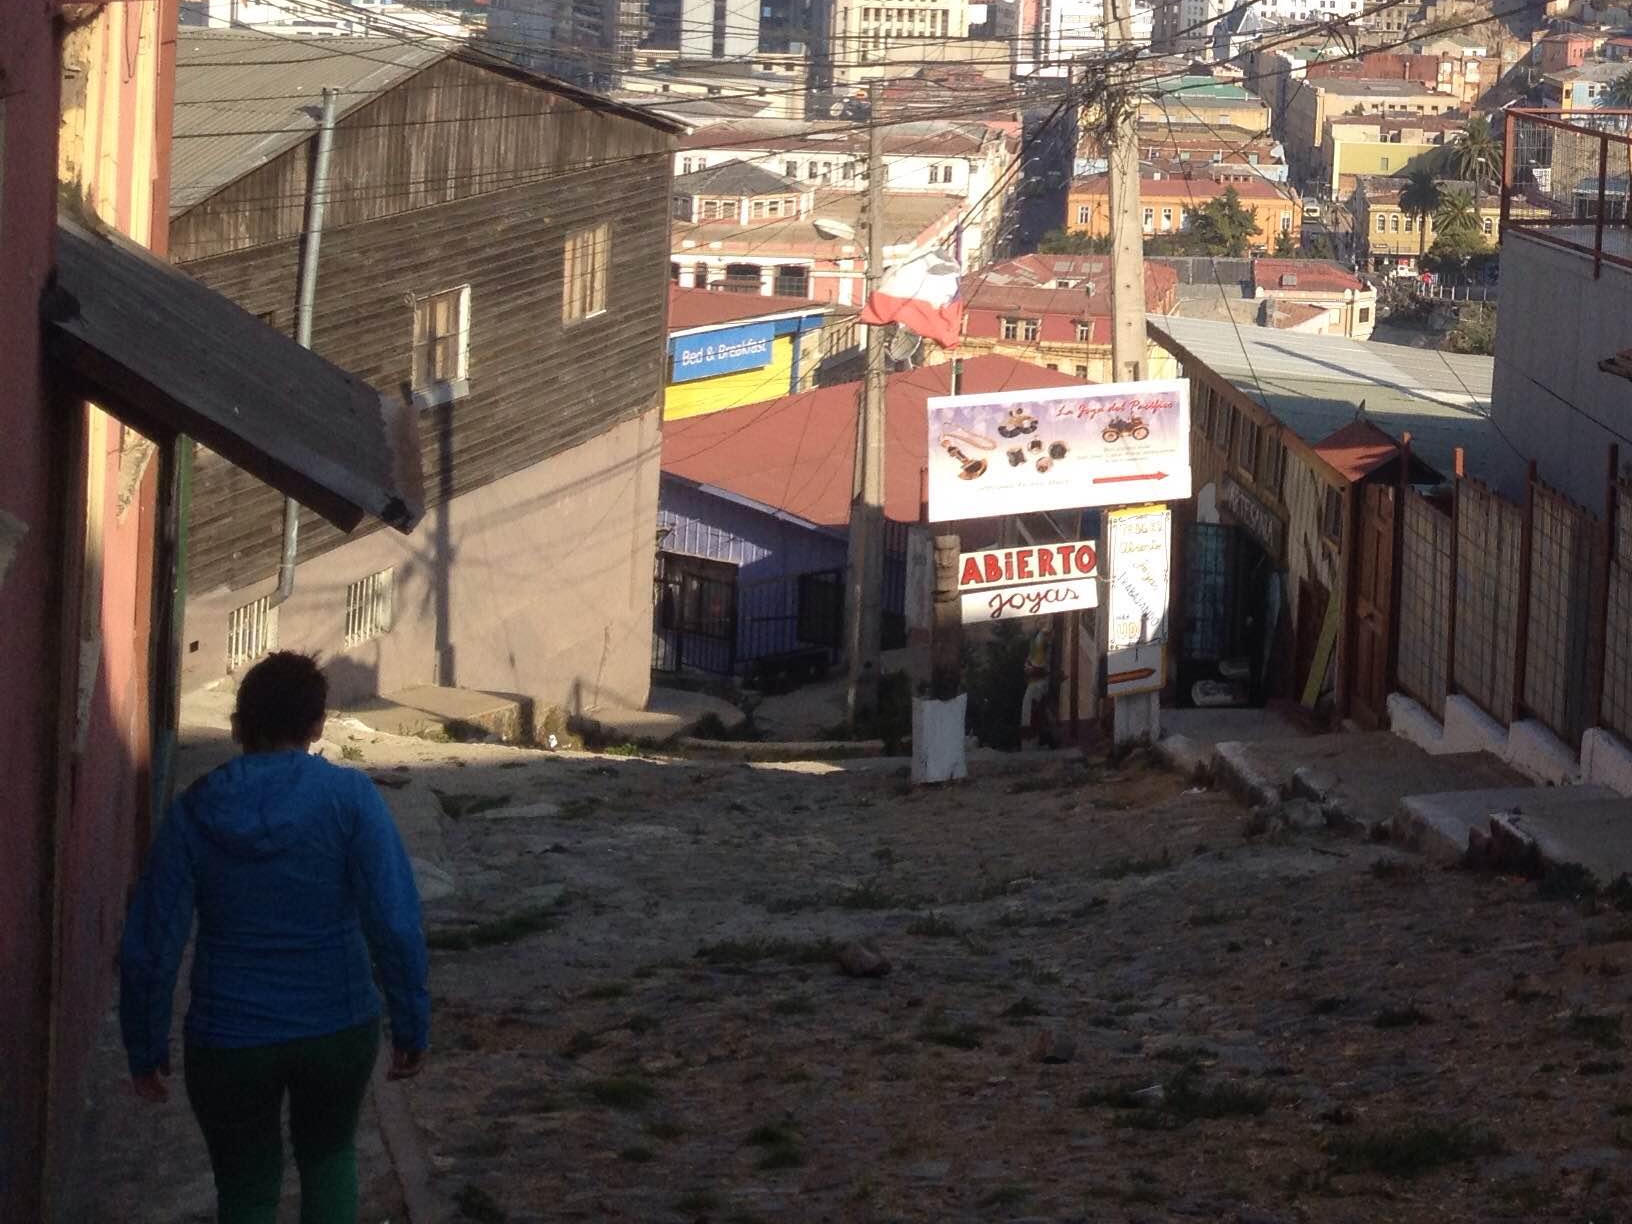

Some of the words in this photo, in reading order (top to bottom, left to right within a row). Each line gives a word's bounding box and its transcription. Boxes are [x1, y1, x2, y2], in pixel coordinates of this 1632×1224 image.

[681, 348, 703, 366] Bed
[705, 344, 717, 362] &
[718, 337, 767, 360] Breakfast
[1107, 401, 1126, 413] del
[988, 587, 1079, 619] Joyas
